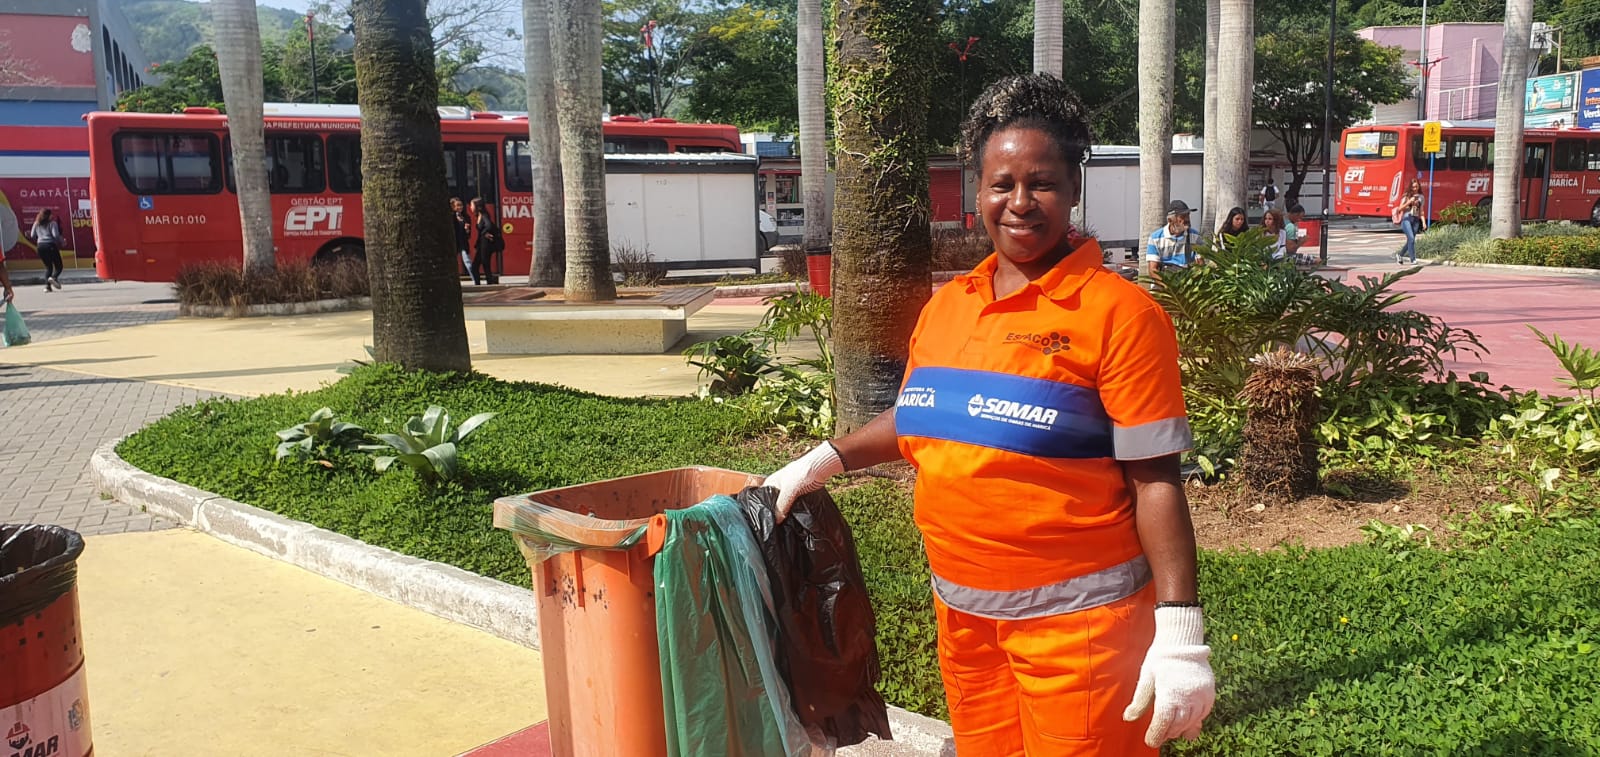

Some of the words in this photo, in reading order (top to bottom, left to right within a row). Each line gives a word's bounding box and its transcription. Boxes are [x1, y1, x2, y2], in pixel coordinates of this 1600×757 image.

[321, 122, 360, 130] MUNICIPAL
[1344, 169, 1365, 181] EPT
[1466, 178, 1490, 192] EPT
[1549, 177, 1578, 187] MARICÁ
[290, 196, 326, 206] GESTÃO
[327, 197, 343, 206] EPT
[145, 215, 170, 225] MAR
[172, 214, 206, 225] 01.010
[284, 205, 344, 231] EPT
[981, 398, 1058, 425] SOMAR
